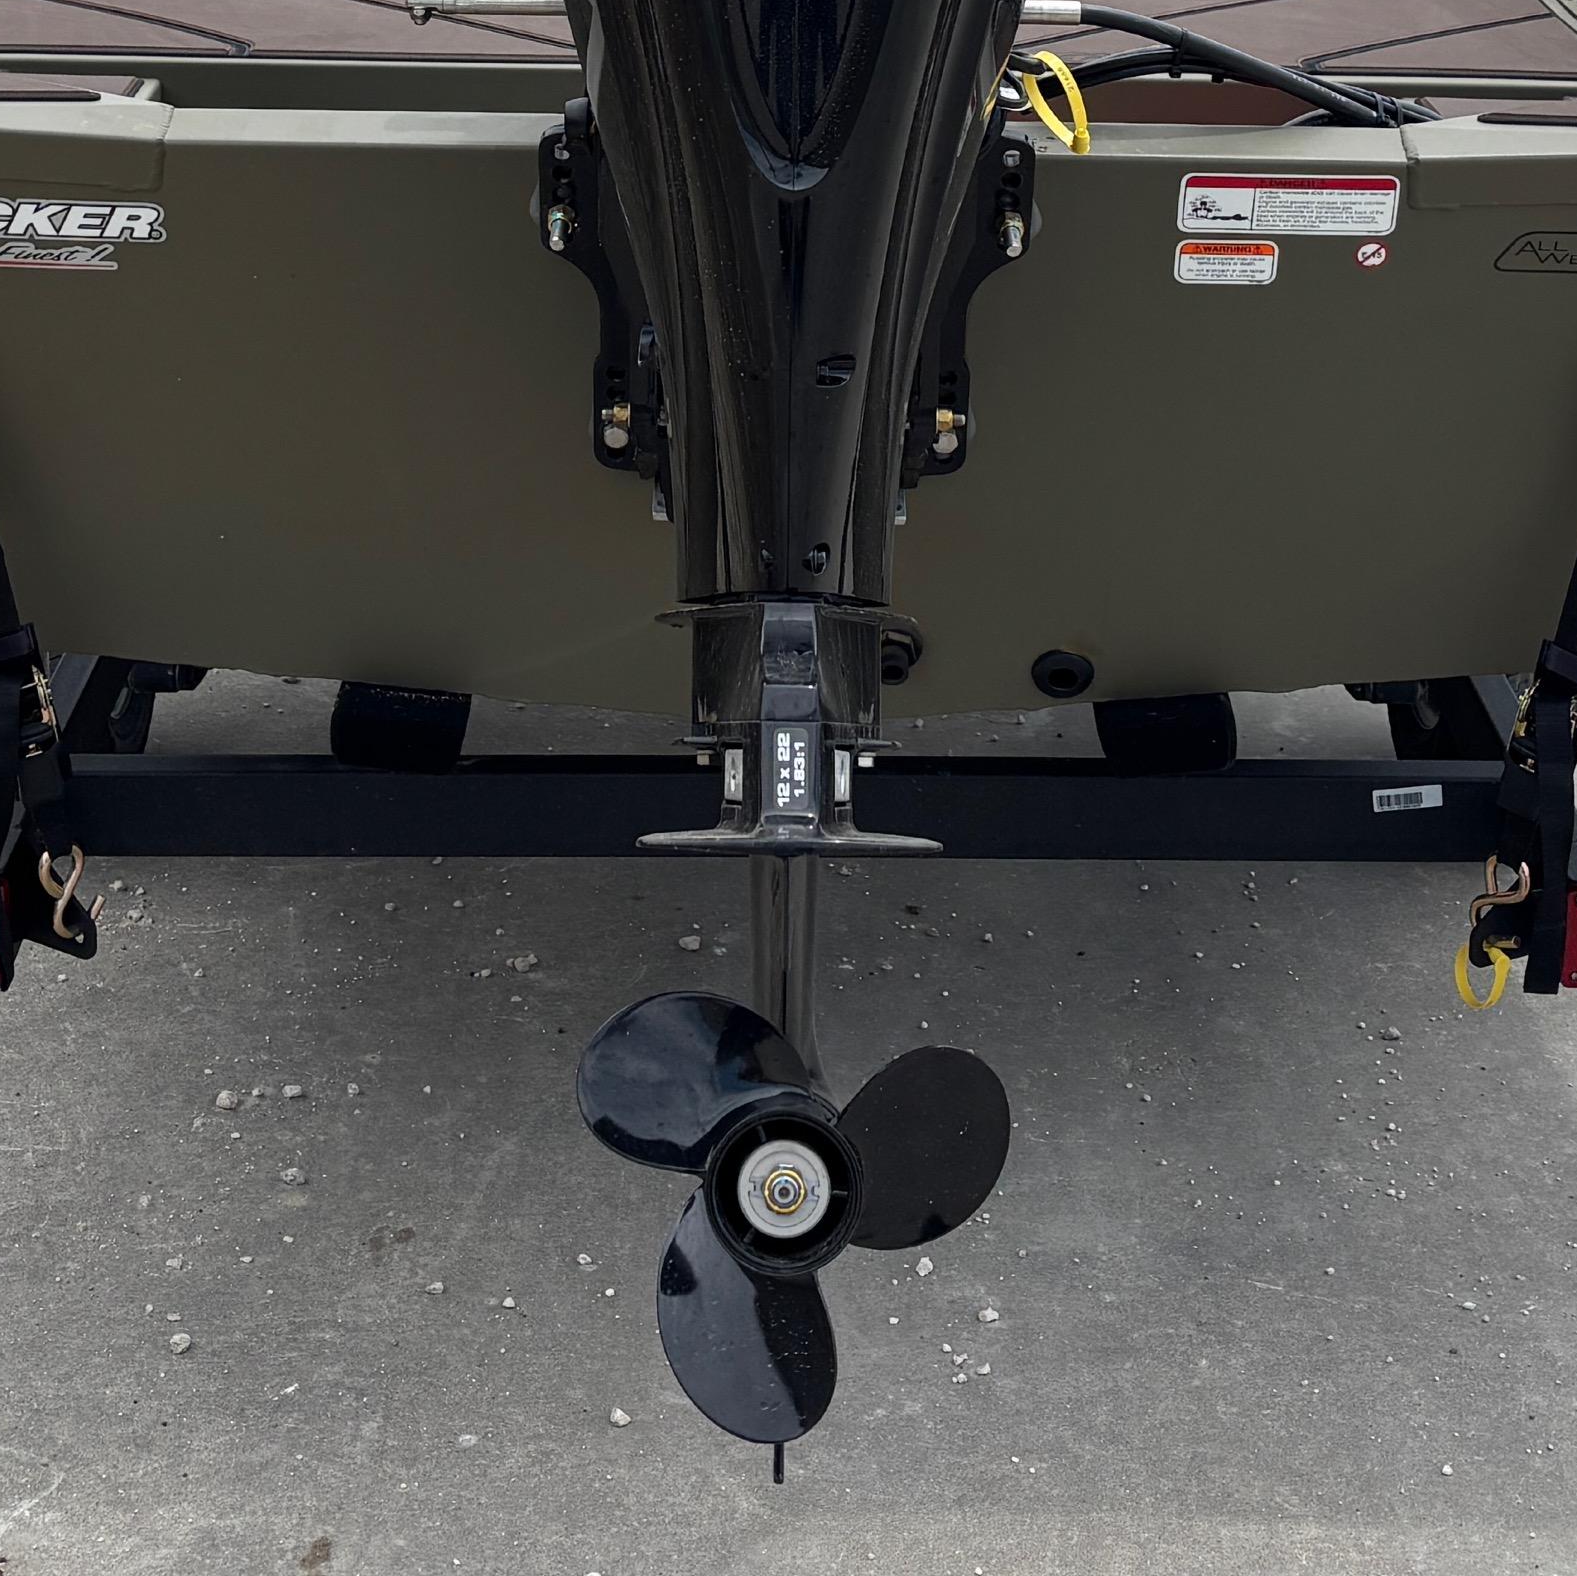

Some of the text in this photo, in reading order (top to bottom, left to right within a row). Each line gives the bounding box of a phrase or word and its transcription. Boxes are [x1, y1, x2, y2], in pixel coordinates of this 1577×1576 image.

[1515, 240, 1569, 256] ALL
[777, 732, 791, 762] 22
[793, 741, 806, 798] 1.83:1
[776, 782, 791, 808] 12
